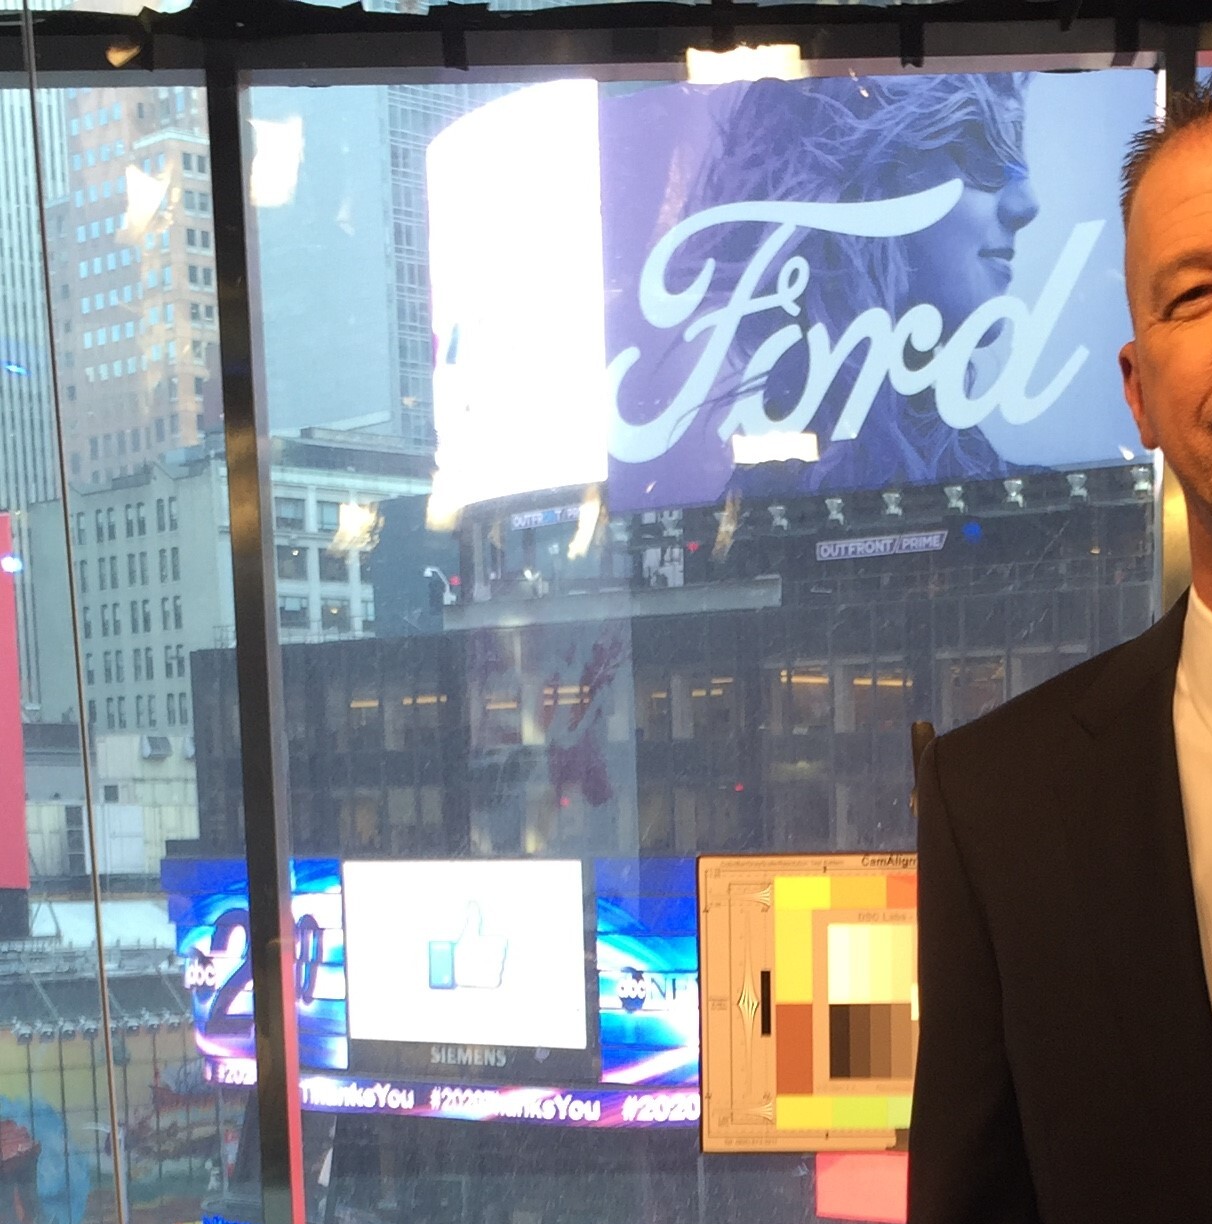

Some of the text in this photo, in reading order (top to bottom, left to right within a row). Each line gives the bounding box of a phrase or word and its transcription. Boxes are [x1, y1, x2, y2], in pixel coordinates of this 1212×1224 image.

[605, 177, 1106, 464] Ford
[820, 535, 941, 558] OUTFRONT PRIME
[430, 1046, 507, 1067] SIEMENS
